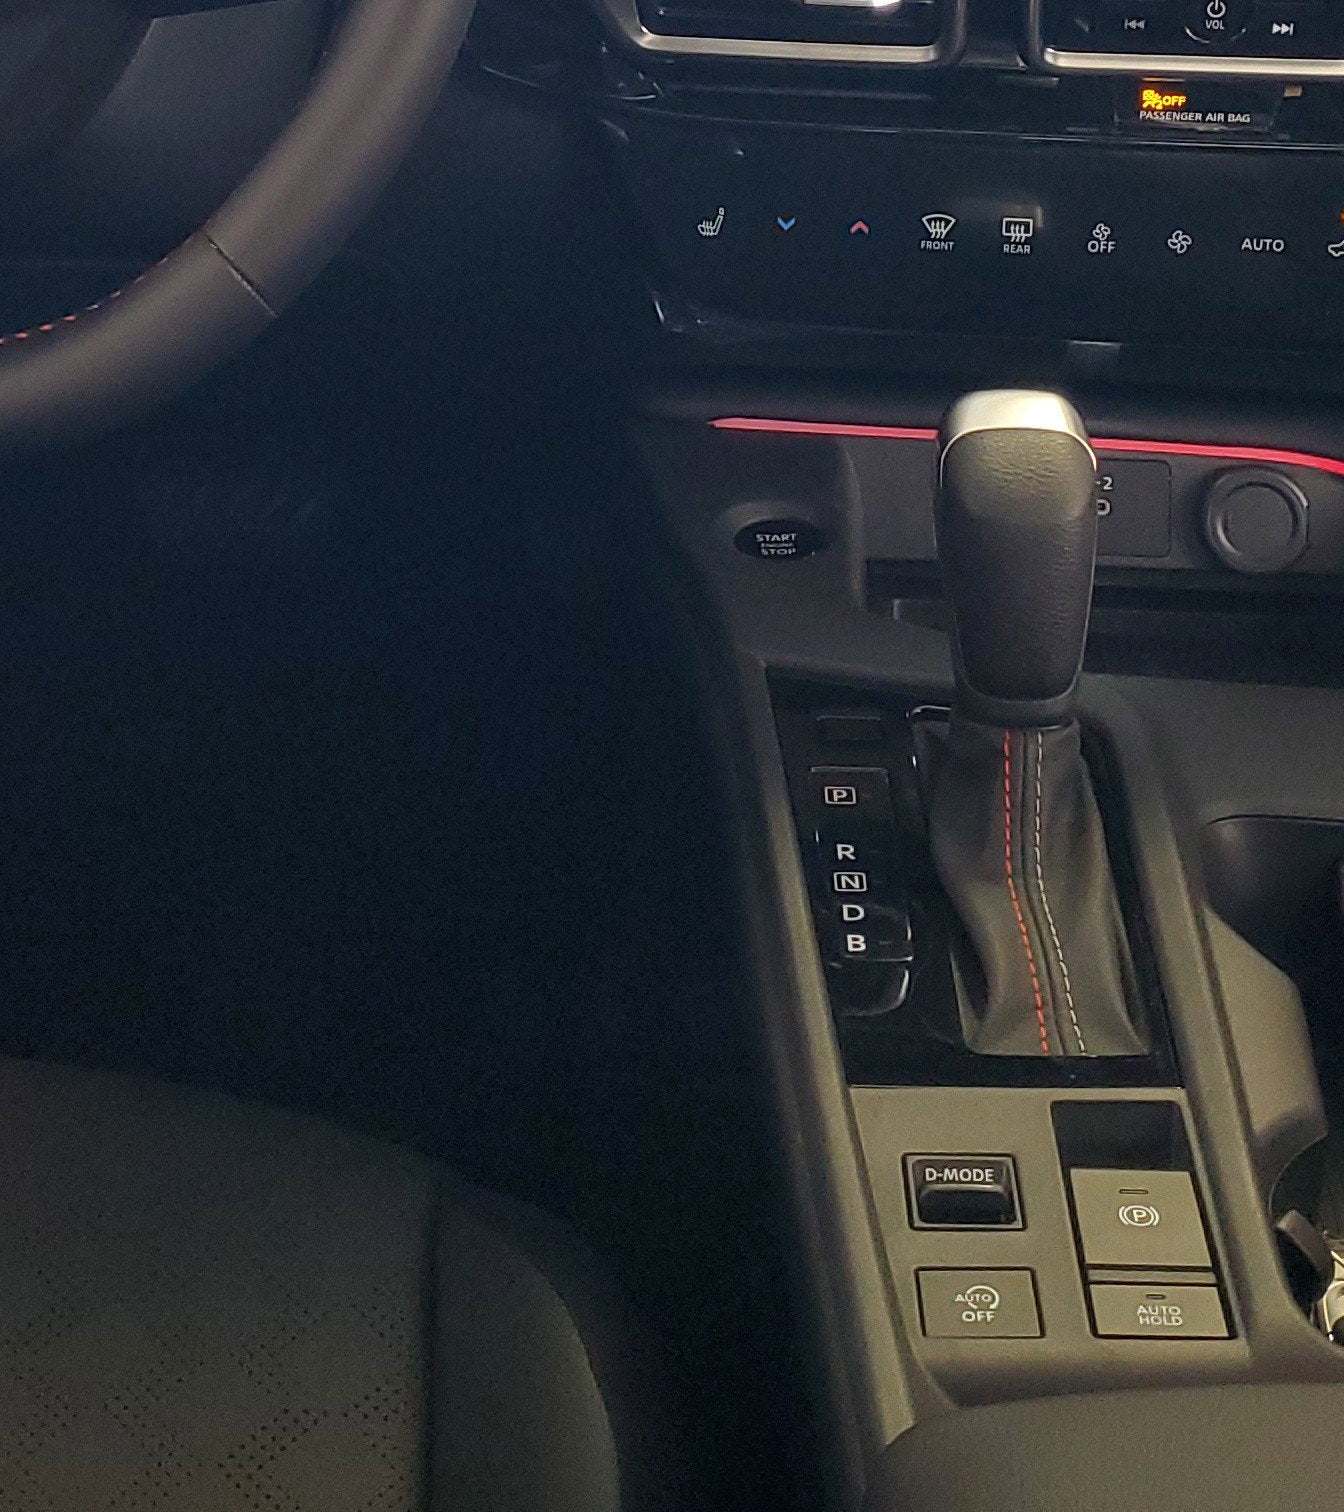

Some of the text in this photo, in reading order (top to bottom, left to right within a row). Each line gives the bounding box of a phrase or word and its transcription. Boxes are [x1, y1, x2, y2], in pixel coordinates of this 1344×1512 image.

[1206, 19, 1225, 31] VOL
[1162, 96, 1186, 107] OFF
[1139, 110, 1251, 123] PASSENGER AIR BAG
[921, 240, 954, 252] FRONT
[1003, 243, 1031, 254] REAR
[1087, 241, 1116, 254] OFF
[1241, 238, 1285, 253] AUTO
[756, 533, 796, 543] START
[833, 789, 847, 801] P
[837, 844, 856, 860] R
[840, 875, 860, 889] N
[842, 905, 864, 921] D
[847, 935, 867, 952] B
[925, 1168, 994, 1183] D-MODE
[955, 1293, 991, 1303] AUTO
[1137, 1305, 1181, 1316] AUTO
[962, 1311, 995, 1323] OFF
[1139, 1315, 1182, 1326] HOLD
